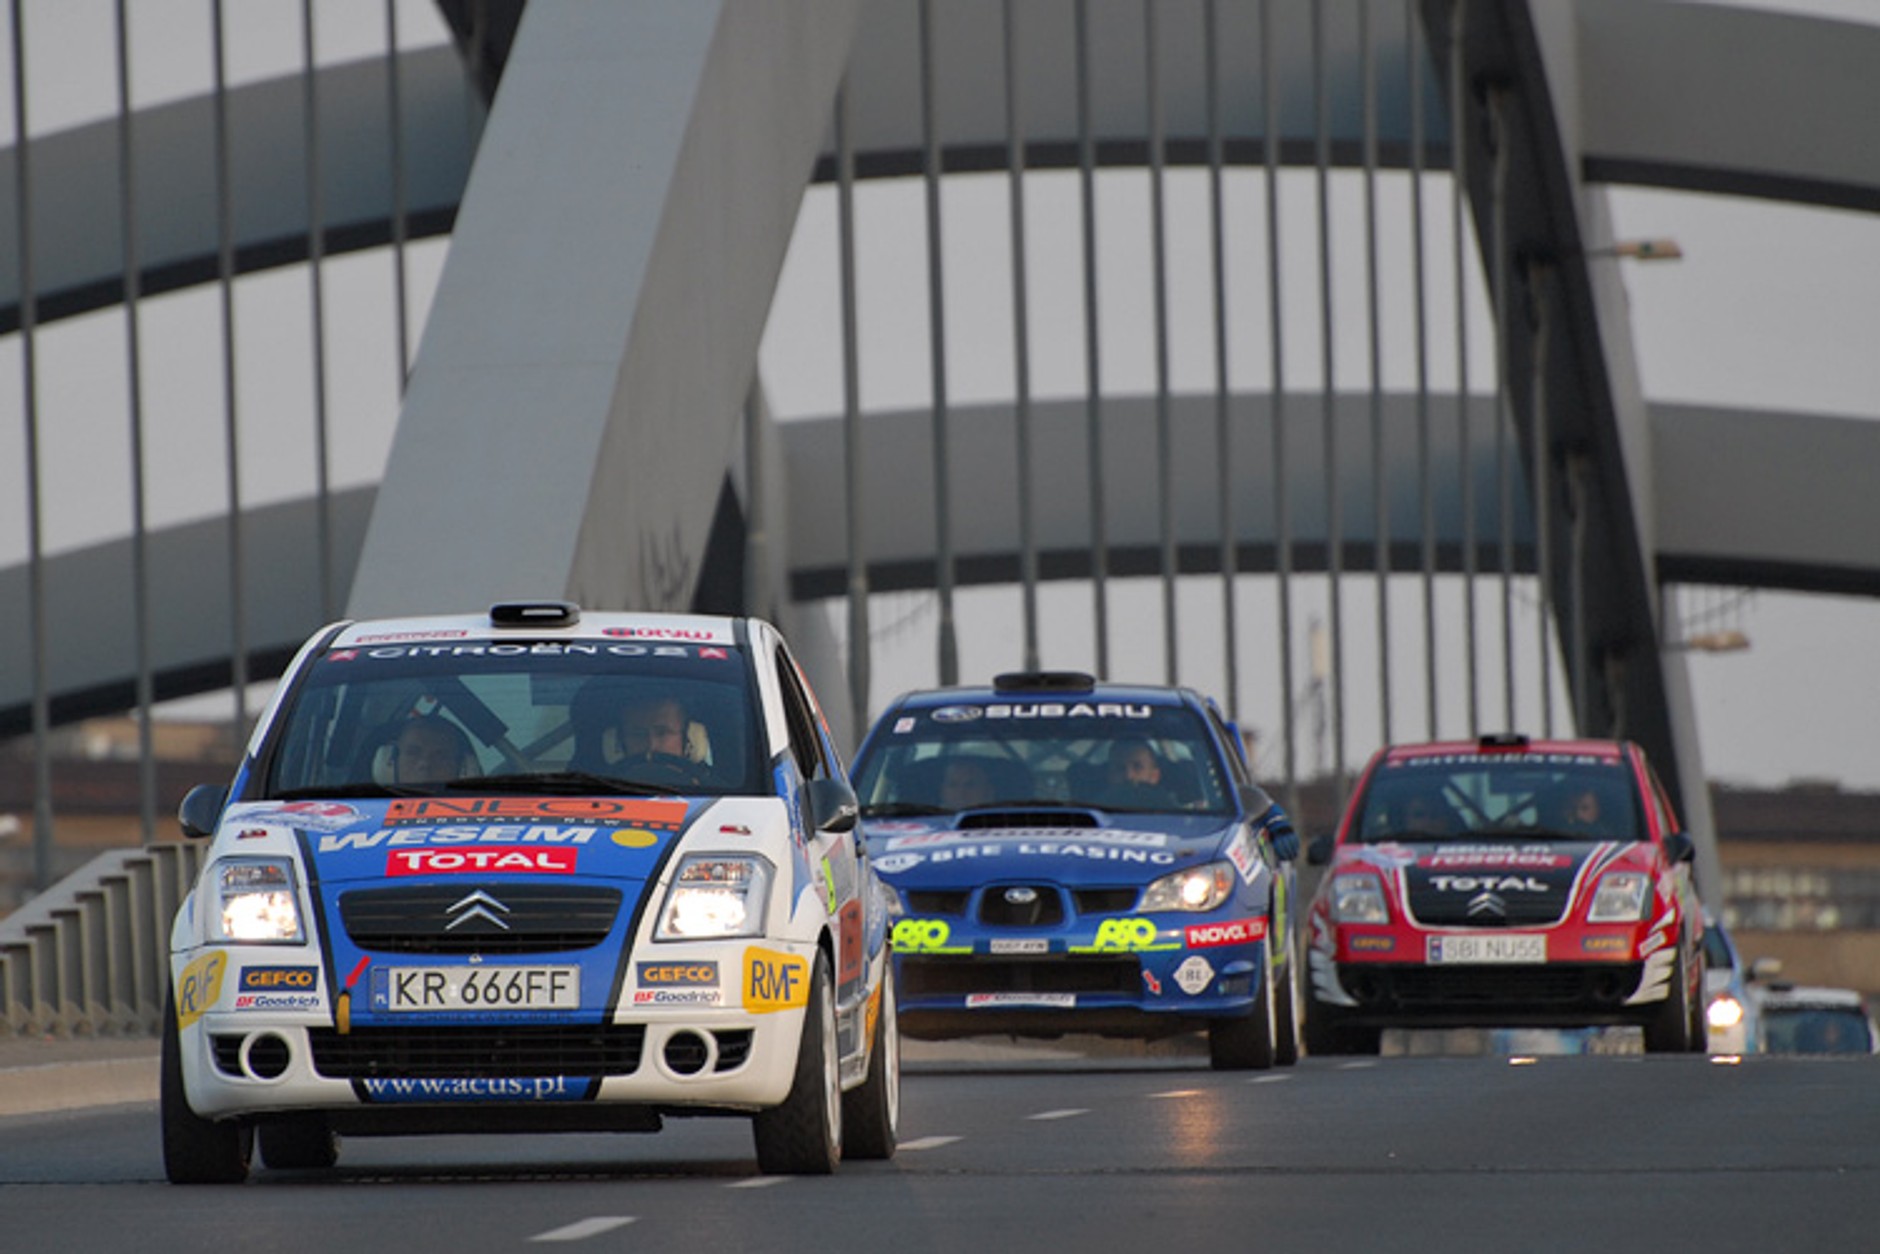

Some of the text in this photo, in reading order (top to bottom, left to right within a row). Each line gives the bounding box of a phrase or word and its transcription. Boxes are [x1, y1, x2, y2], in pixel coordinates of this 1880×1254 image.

[985, 704, 1151, 718] SUBARU
[318, 825, 597, 852] WESEM
[396, 849, 567, 870] TOTAL
[931, 843, 1175, 865] BRE LEASING
[1429, 876, 1549, 891] TOTAL
[246, 970, 313, 986] GEFCO
[643, 966, 715, 982] GEFCO
[751, 960, 801, 1001] RMF
[395, 969, 570, 1005] KR 666FF
